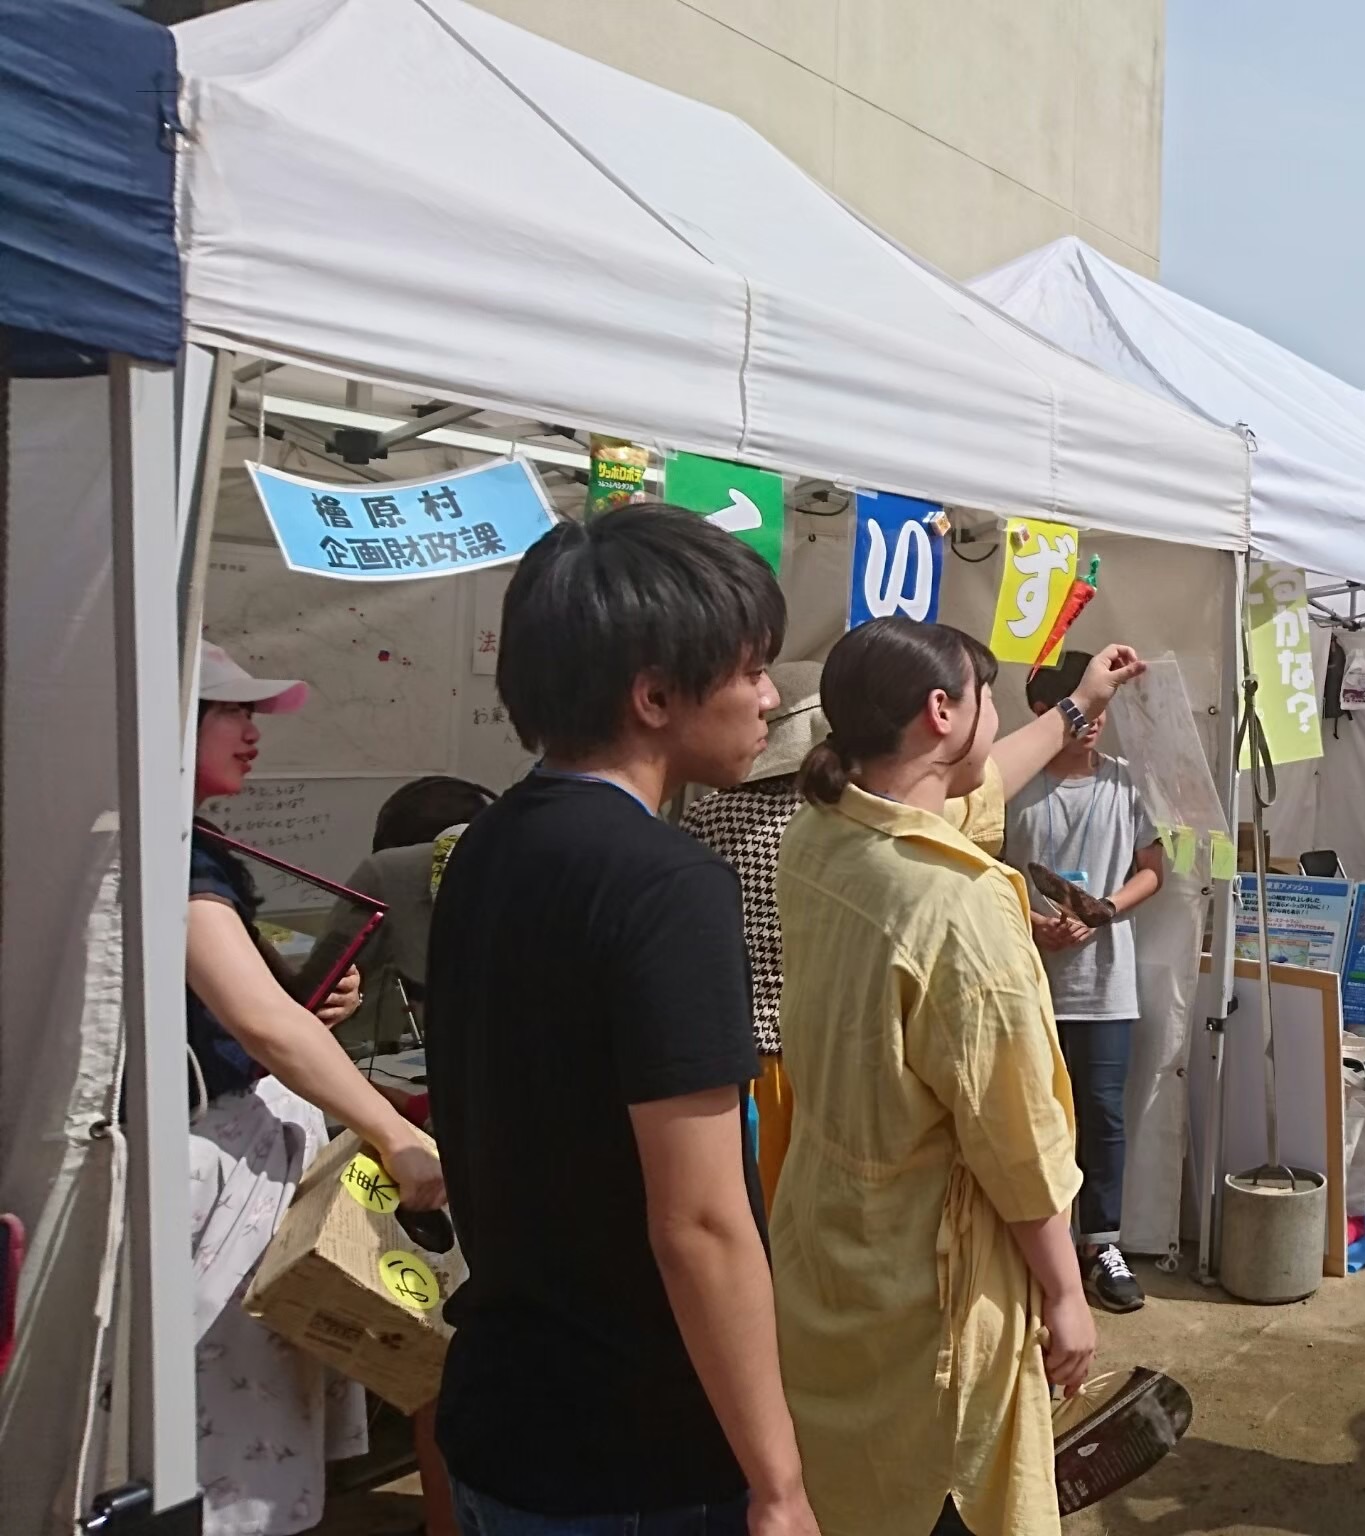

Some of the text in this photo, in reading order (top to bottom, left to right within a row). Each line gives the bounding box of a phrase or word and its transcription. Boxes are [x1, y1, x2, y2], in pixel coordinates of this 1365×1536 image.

[312, 486, 463, 528] 檜原村
[319, 521, 507, 570] 企画財政課
[1007, 533, 1075, 639] ず
